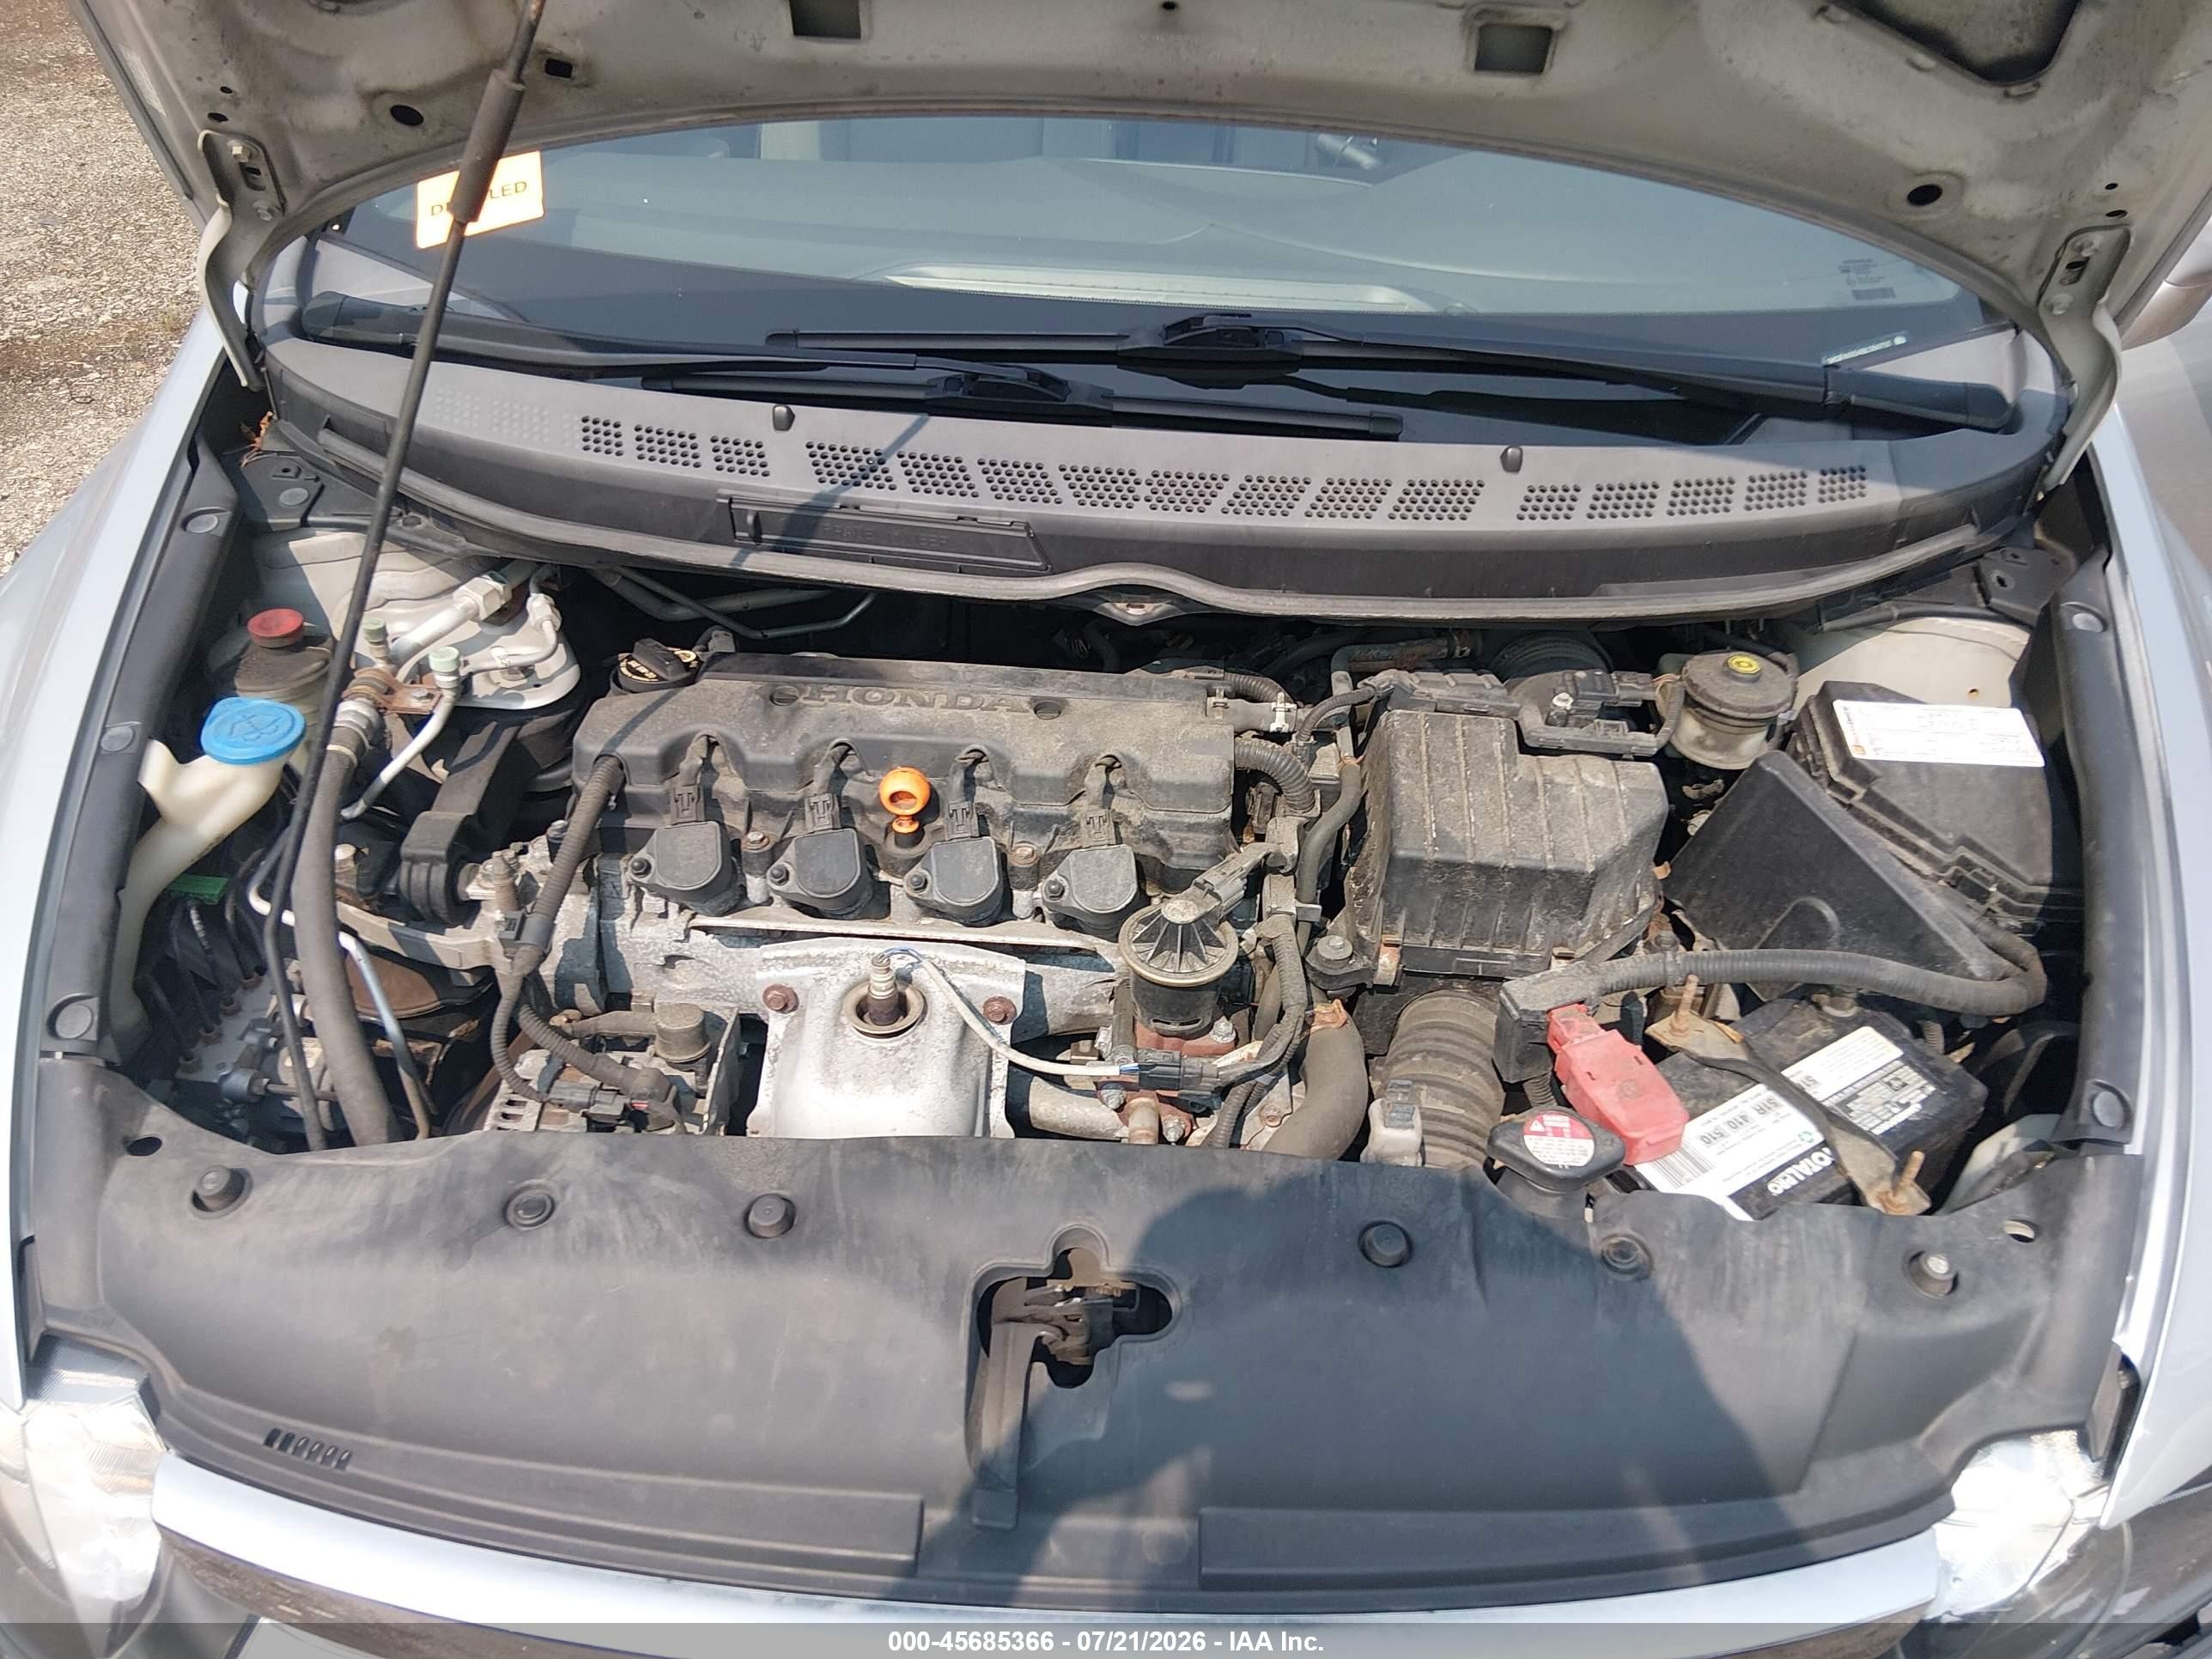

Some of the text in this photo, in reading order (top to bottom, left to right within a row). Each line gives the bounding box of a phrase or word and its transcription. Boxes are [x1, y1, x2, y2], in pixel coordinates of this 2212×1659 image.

[802, 686, 1030, 713] HONDA
[1753, 1098, 1780, 1115] 51R
[1727, 1114, 1749, 1129] 410
[1699, 1130, 1725, 1145] 510
